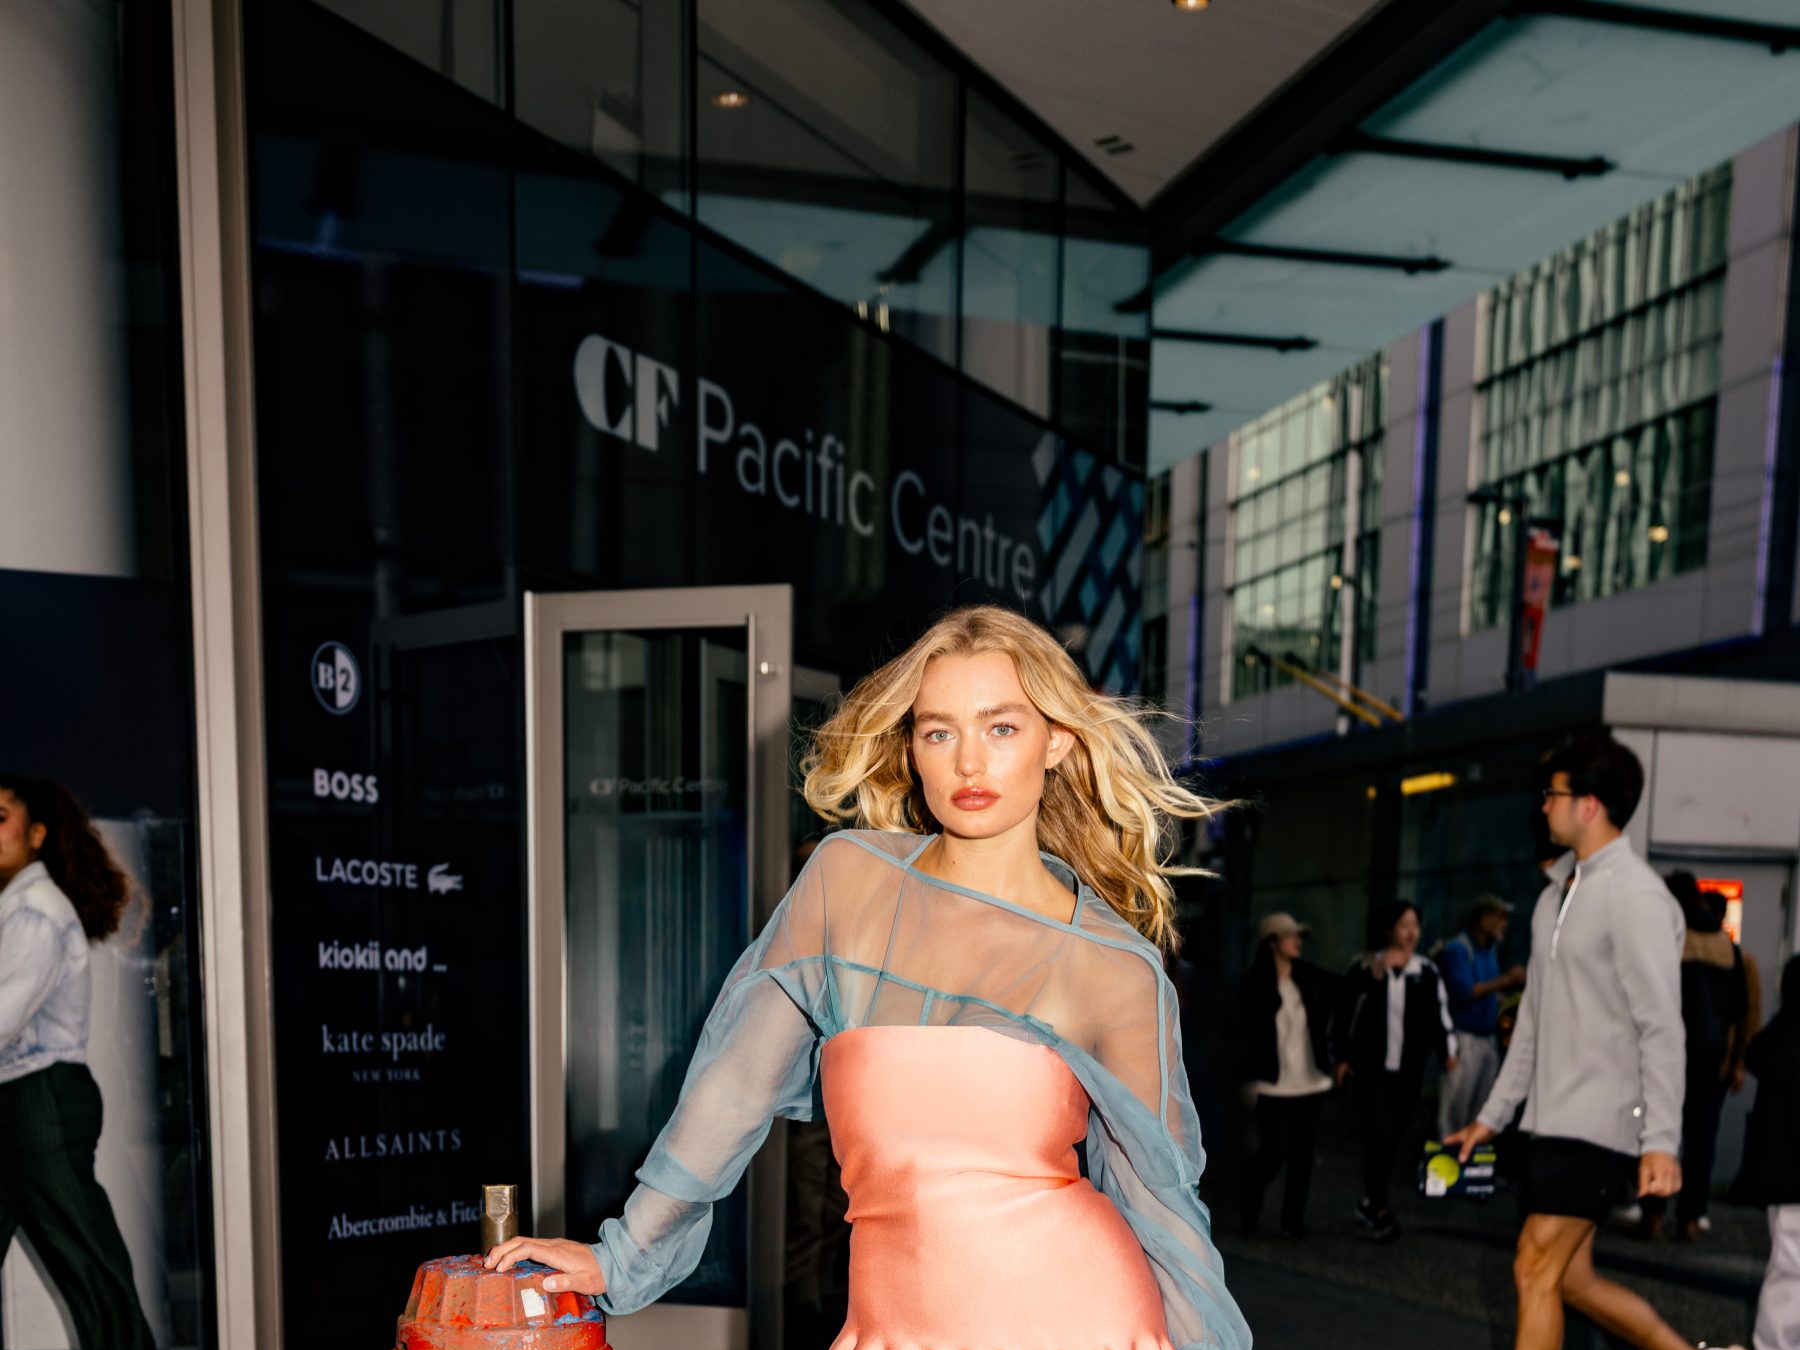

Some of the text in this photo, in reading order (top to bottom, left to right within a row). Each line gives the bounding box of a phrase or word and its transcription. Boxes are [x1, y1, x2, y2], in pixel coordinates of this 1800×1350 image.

[573, 333, 1038, 602] CF Pacific Centre
[313, 768, 379, 805] BOSS
[316, 857, 418, 890] LACOSTE
[318, 940, 380, 970] kiokii
[384, 945, 428, 972] and
[322, 1023, 446, 1061] kate spade
[352, 1068, 421, 1082] NEW YORK
[325, 1129, 463, 1161] ALLSAINTS
[327, 1205, 434, 1240] Abercrombie
[435, 1209, 448, 1226] &
